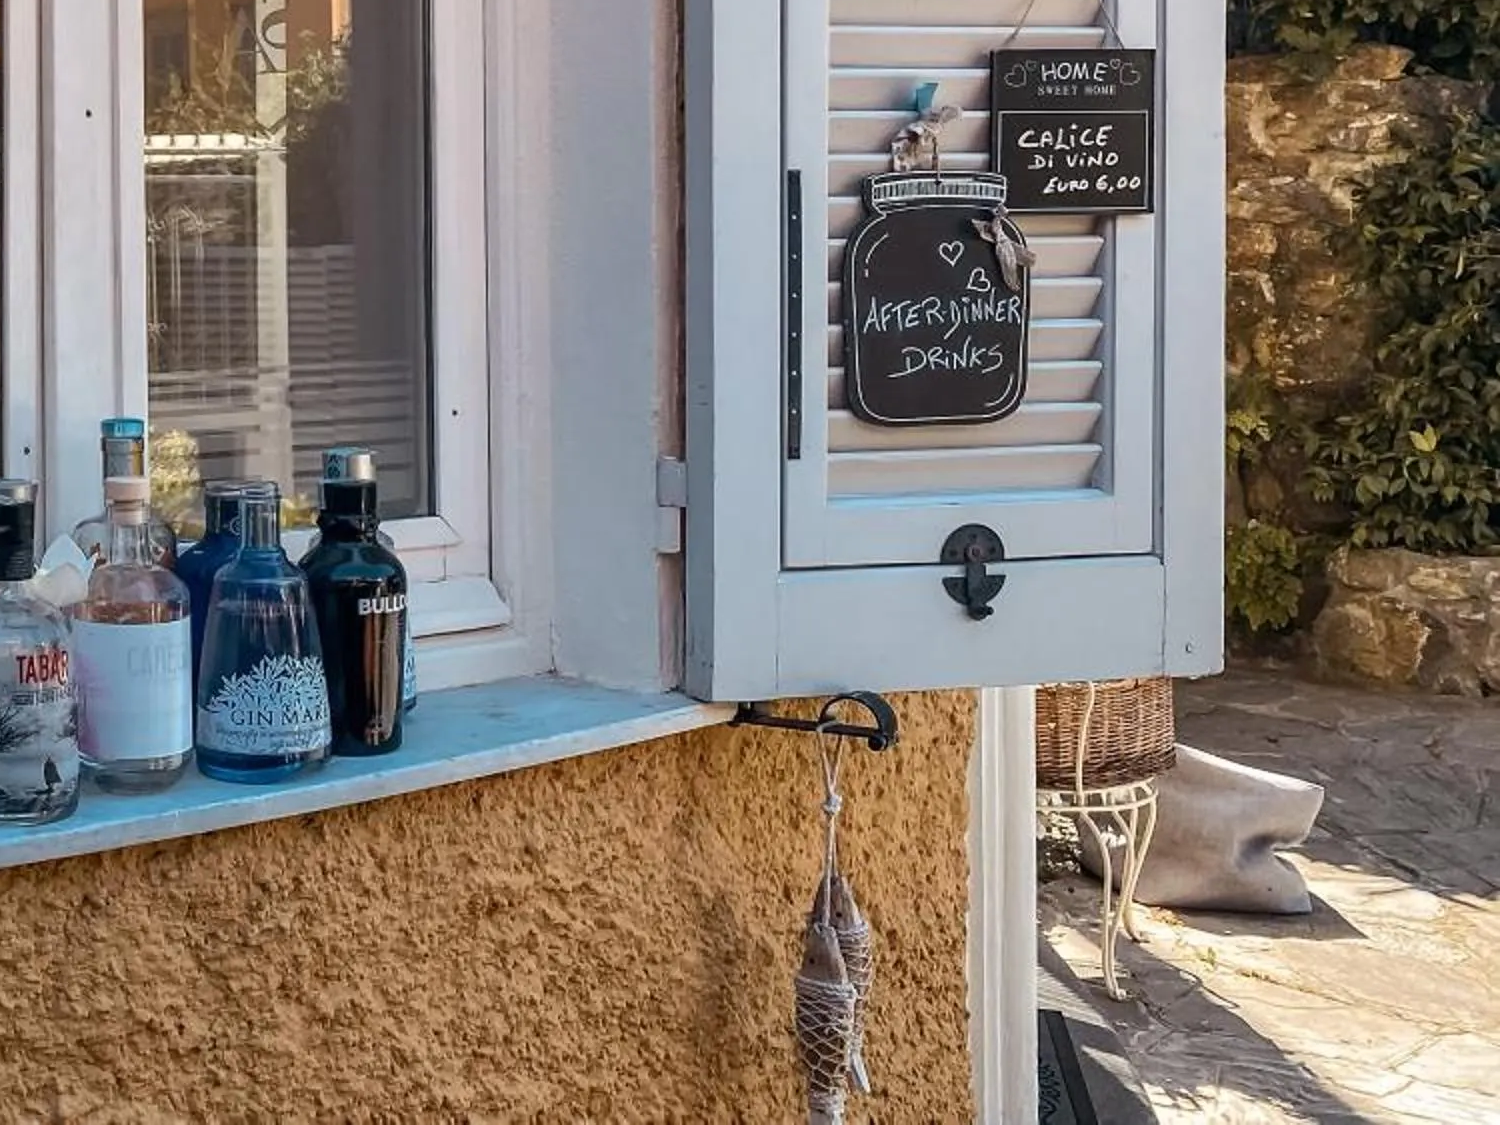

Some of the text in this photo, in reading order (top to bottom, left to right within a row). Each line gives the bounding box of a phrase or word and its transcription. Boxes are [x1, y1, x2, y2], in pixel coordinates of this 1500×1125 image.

[1041, 62, 1109, 82] HOME
[1037, 85, 1117, 96] SWEET HOME
[1043, 175, 1141, 194] EURO 6,00
[230, 710, 274, 726] GIN
